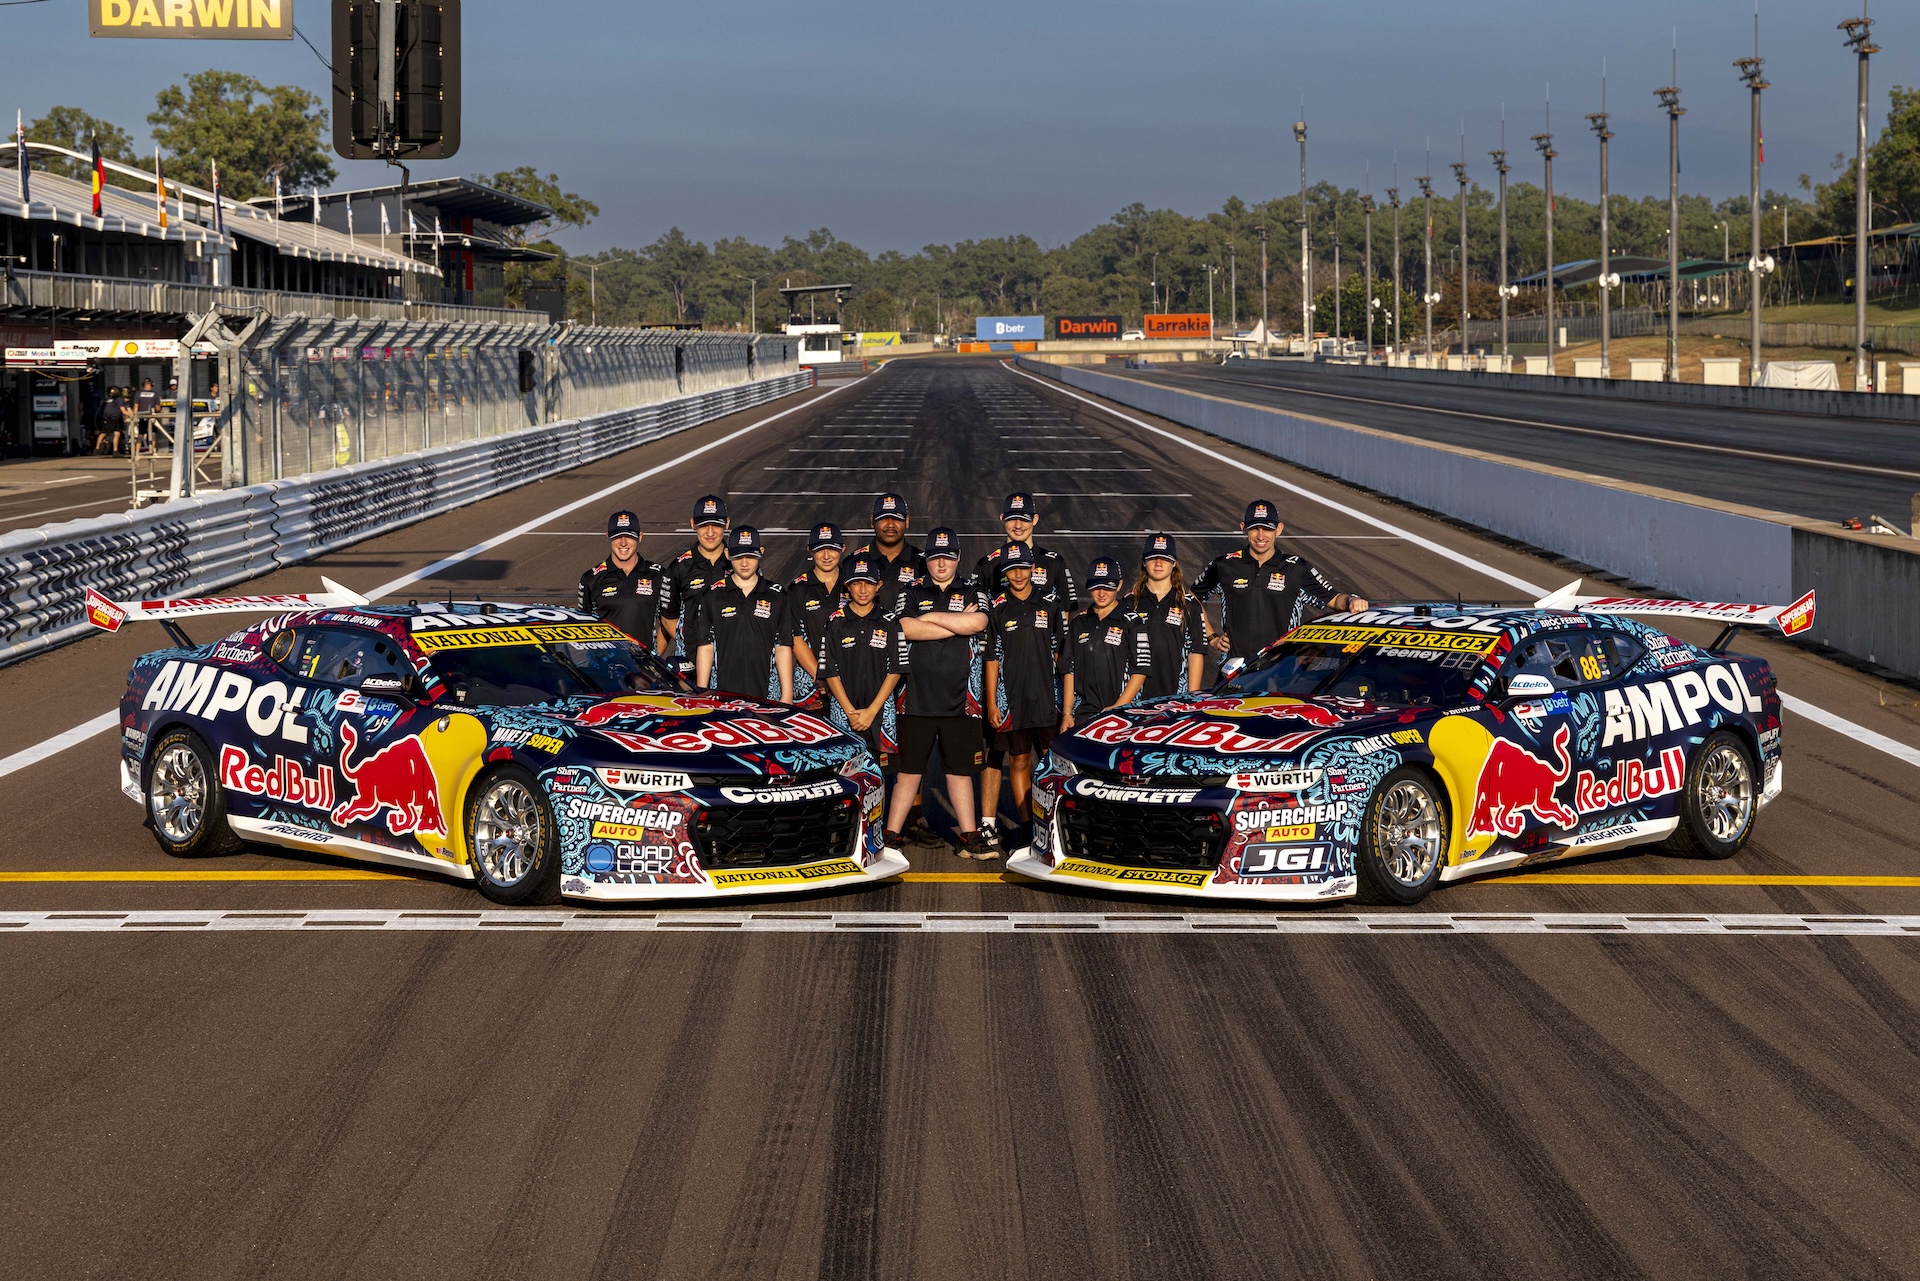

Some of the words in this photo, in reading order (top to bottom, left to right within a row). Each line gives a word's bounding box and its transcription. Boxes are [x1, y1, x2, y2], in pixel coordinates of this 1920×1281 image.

[101, 0, 281, 28] DARWIN
[1006, 324, 1025, 333] betr
[1060, 319, 1117, 333] Darwin
[1148, 318, 1209, 331] Larrakia
[87, 595, 123, 622] SUPERCHEAP
[145, 603, 257, 616] Premium
[265, 601, 326, 609] Fuels
[1578, 604, 1682, 613] Premium
[1691, 609, 1756, 620] Fuels
[1612, 597, 1771, 613] AMPLIFY
[1780, 597, 1814, 627] SUPERCHEAP
[331, 613, 351, 621] WILL
[349, 615, 382, 627] BROWN
[411, 609, 598, 631] AMPOL
[1312, 611, 1503, 634] AMPOL
[1539, 617, 1561, 628] BROC
[1560, 616, 1588, 625] FEENEY
[417, 630, 531, 649] NATIONAL
[533, 625, 621, 641] STORAGE
[572, 641, 614, 650] Brown
[1291, 628, 1379, 643] NATIONAL
[1380, 631, 1490, 650] STORAGE
[1645, 633, 1671, 650] Shaw
[1376, 645, 1444, 662] Feeney
[1653, 650, 1695, 667] Partners
[308, 655, 320, 678] 1
[1579, 656, 1601, 680] 88
[363, 678, 402, 687] ACDelco
[141, 660, 309, 744] AMPOL
[440, 704, 477, 714] DUNLOP
[1449, 705, 1481, 716] DUNLOP
[1553, 697, 1569, 709] betr
[1601, 662, 1763, 747] AMPOL
[491, 727, 522, 742] MAKE
[515, 731, 533, 744] IT
[526, 733, 565, 755] SUPER
[1352, 736, 1387, 756] MAKE
[1380, 733, 1397, 747] IT
[1391, 729, 1425, 745] SUPER
[557, 766, 580, 776] Shaw
[1327, 766, 1348, 776] Shaw
[552, 781, 588, 793] Partners
[719, 782, 844, 804] COMPLETE
[1076, 778, 1197, 804] COMPLETE
[1331, 782, 1367, 793] Partners
[567, 798, 683, 832] SUPERCHEAP
[1235, 800, 1348, 832] SUPERCHEAP
[598, 825, 638, 837] AUTO
[1271, 827, 1311, 838] AUTO
[1575, 825, 1638, 845] FREIGHTER
[616, 845, 673, 861] QUAD
[1248, 846, 1326, 873] JGI
[616, 860, 673, 875] LOCK
[716, 869, 799, 885] NATIONAL
[804, 861, 858, 878] STORAGE
[1059, 862, 1118, 877] NATIONAL
[1124, 869, 1203, 885] STORAGE
